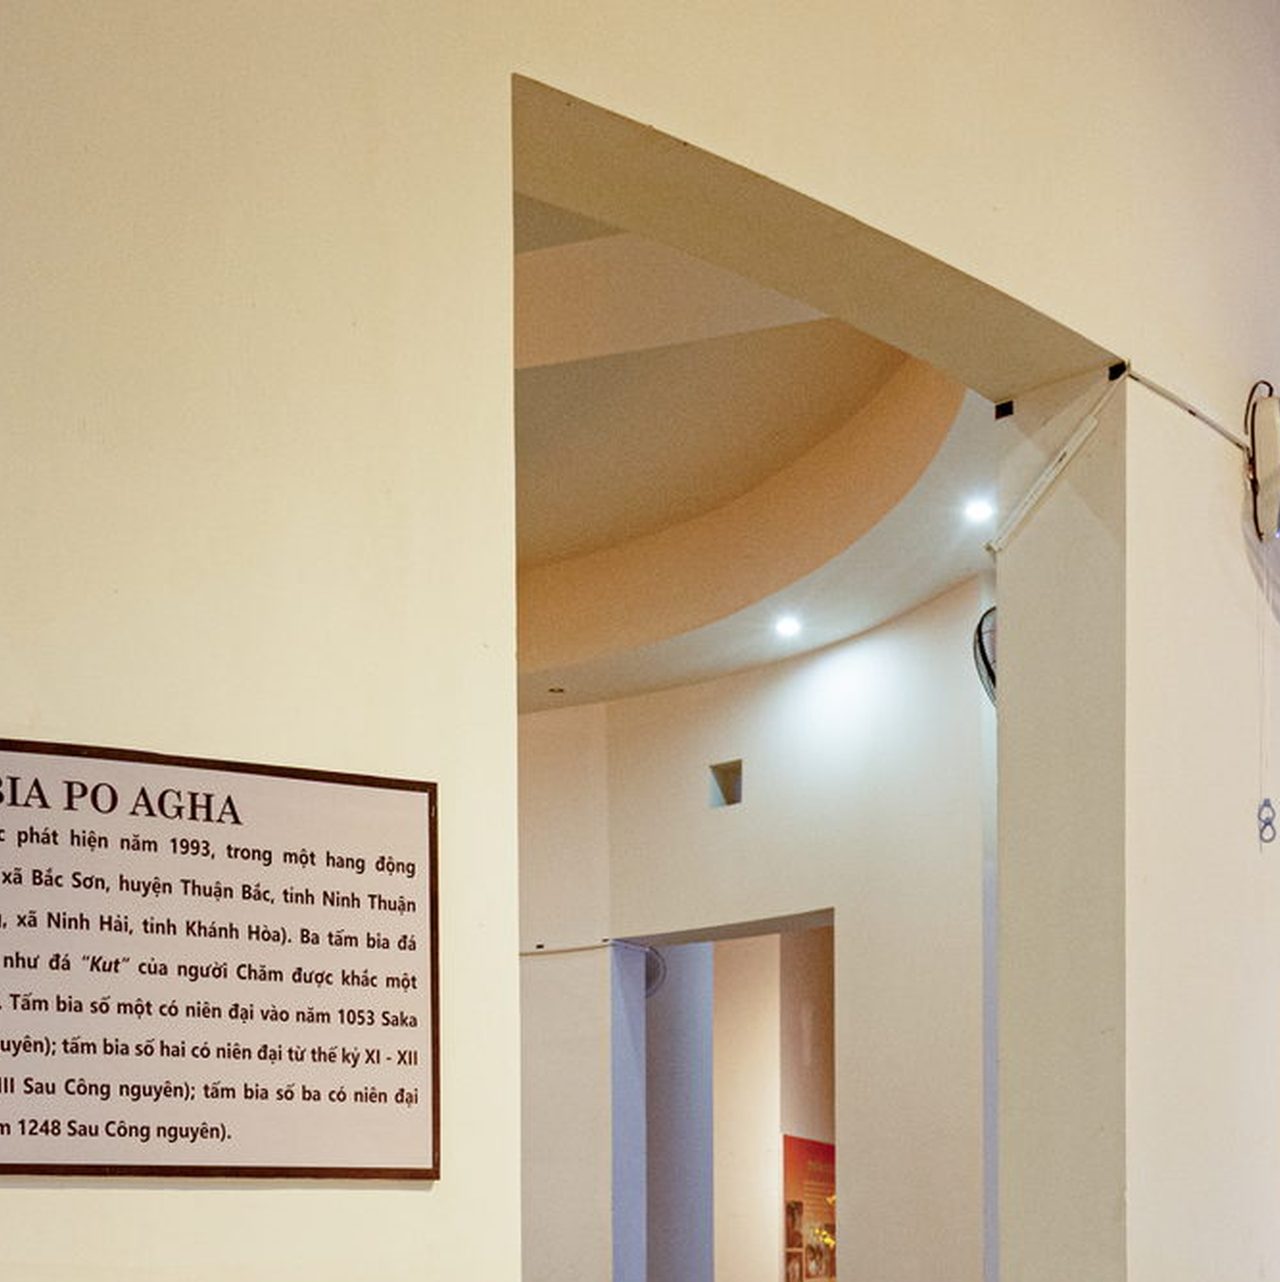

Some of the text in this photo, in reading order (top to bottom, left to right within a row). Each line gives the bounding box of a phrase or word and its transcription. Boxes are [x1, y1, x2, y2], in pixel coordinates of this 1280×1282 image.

[63, 781, 118, 814] PO
[129, 786, 243, 825] AGHA
[17, 826, 59, 848] phát
[70, 829, 108, 852] hiện
[120, 834, 158, 853] năm
[170, 838, 215, 860] 1993,
[226, 844, 272, 867] trong
[283, 848, 316, 868] một
[326, 851, 365, 874] hang
[375, 856, 416, 878] động
[2, 867, 22, 885] xã
[32, 868, 63, 888] Bắc
[72, 871, 110, 893] Sơn,
[119, 874, 172, 898] huyện
[180, 879, 233, 901] Thuận
[242, 883, 274, 904] Bắc,
[282, 886, 315, 905] tỉnh
[323, 890, 360, 909] Ninh
[367, 894, 416, 915] Thuận
[17, 910, 37, 928] xã
[47, 912, 90, 930] Ninh
[100, 914, 133, 935] Hải,
[142, 916, 177, 935] tỉnh
[186, 920, 239, 939] Khánh
[248, 924, 292, 946] Hòa).
[300, 928, 320, 945] Ba
[327, 929, 358, 947] tấm
[366, 932, 390, 949] bia
[397, 934, 416, 951] đá
[4, 951, 40, 969] như
[48, 953, 71, 971] đá
[138, 957, 168, 976] của
[177, 962, 227, 982] người
[236, 963, 283, 982] Chăm
[292, 967, 333, 988] được
[341, 969, 377, 987] khắc
[386, 973, 417, 993] một
[9, 992, 49, 1011] Tấm
[56, 994, 83, 1013] bia
[90, 995, 111, 1014] số
[117, 998, 152, 1019] một
[159, 1000, 179, 1017] có
[186, 1001, 222, 1018] niên
[228, 1003, 254, 1024] đại
[260, 1004, 289, 1022] vào
[296, 1007, 331, 1023] năm
[338, 1009, 375, 1026] 1053
[381, 1011, 418, 1028] Saka
[62, 1036, 97, 1054] tấm
[103, 1038, 129, 1056] bia
[135, 1038, 155, 1057] số
[160, 1040, 185, 1057] hai
[191, 1042, 211, 1058] có
[216, 1042, 252, 1060] niên
[257, 1044, 282, 1064] đại
[287, 1045, 306, 1062] từ
[311, 1045, 337, 1063] thế
[340, 1047, 360, 1068] kỷ
[365, 1049, 380, 1064] XI
[397, 1050, 418, 1066] XII
[23, 1077, 56, 1095] Sau
[64, 1078, 111, 1101] Công
[119, 1080, 195, 1102] nguyên);
[203, 1081, 236, 1099] tấm
[244, 1083, 268, 1100] bia
[276, 1083, 295, 1101] số
[302, 1085, 321, 1101] ba
[328, 1086, 347, 1102] có
[354, 1086, 387, 1103] niên
[394, 1088, 418, 1108] đại
[18, 1119, 61, 1136] 1248
[67, 1120, 99, 1137] Sau
[105, 1120, 150, 1143] Công
[157, 1122, 231, 1143] nguyên).
